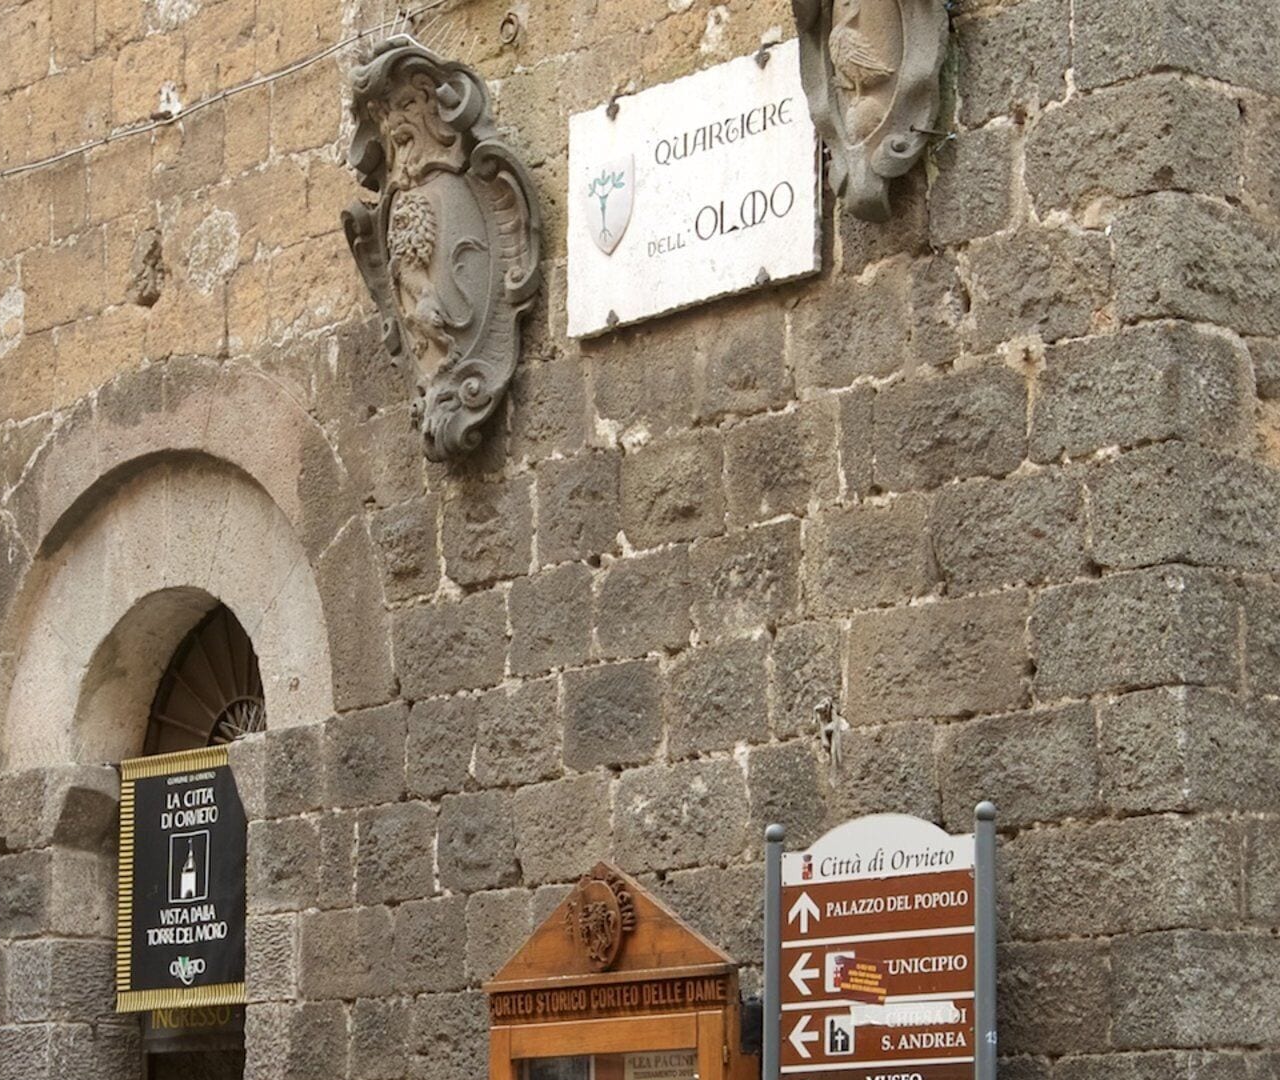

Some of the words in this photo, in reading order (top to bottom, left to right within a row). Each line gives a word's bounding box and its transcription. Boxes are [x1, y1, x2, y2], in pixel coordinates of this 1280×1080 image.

[654, 97, 794, 166] QUARTIERE
[166, 791, 181, 810] LA
[160, 812, 173, 830] DI
[174, 804, 219, 829] ORVIETO
[820, 854, 861, 877] Città
[868, 853, 884, 872] di
[891, 849, 955, 871] Orvieto
[159, 907, 189, 926] VISTA
[189, 904, 217, 924] DALLA
[826, 898, 885, 918] PALAZZO
[887, 895, 913, 912] DEL
[914, 889, 969, 911] POPOLO
[146, 927, 176, 947] TORRE
[176, 925, 196, 946] DEL
[196, 922, 228, 943] MORO
[883, 955, 968, 976] UNICIPIO
[490, 994, 533, 1018] CORTEO
[536, 989, 587, 1014] STORICO
[590, 985, 639, 1010] CORTEO
[642, 981, 682, 1005] DELLE
[685, 978, 726, 1002] DAME
[151, 1007, 231, 1030] INGRESSO
[881, 1034, 895, 1051] S.
[898, 1031, 967, 1050] ANDREA
